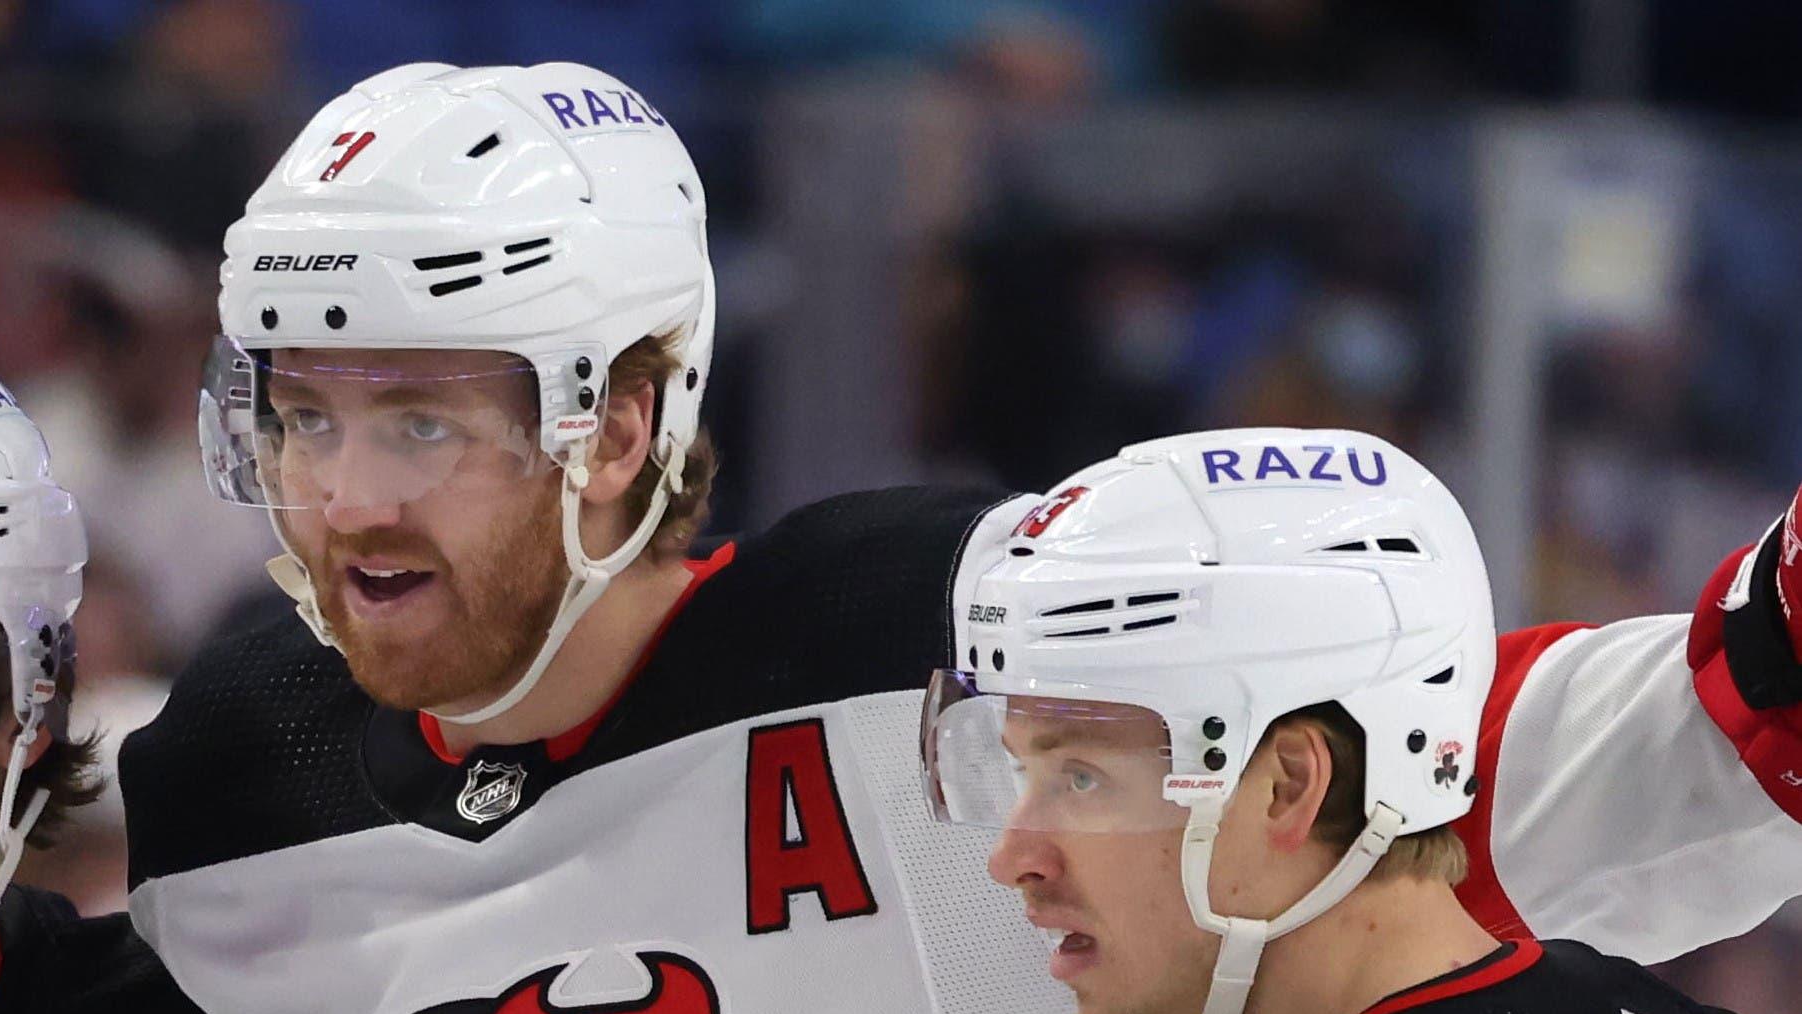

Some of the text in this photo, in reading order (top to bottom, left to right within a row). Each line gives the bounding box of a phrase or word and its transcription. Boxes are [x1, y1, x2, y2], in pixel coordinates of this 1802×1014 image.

[319, 131, 376, 182] 7
[253, 254, 359, 272] BAUER
[1202, 446, 1387, 487] RAZU
[472, 778, 515, 810] NHL
[1167, 780, 1225, 789] BAUER
[747, 718, 879, 936] A
